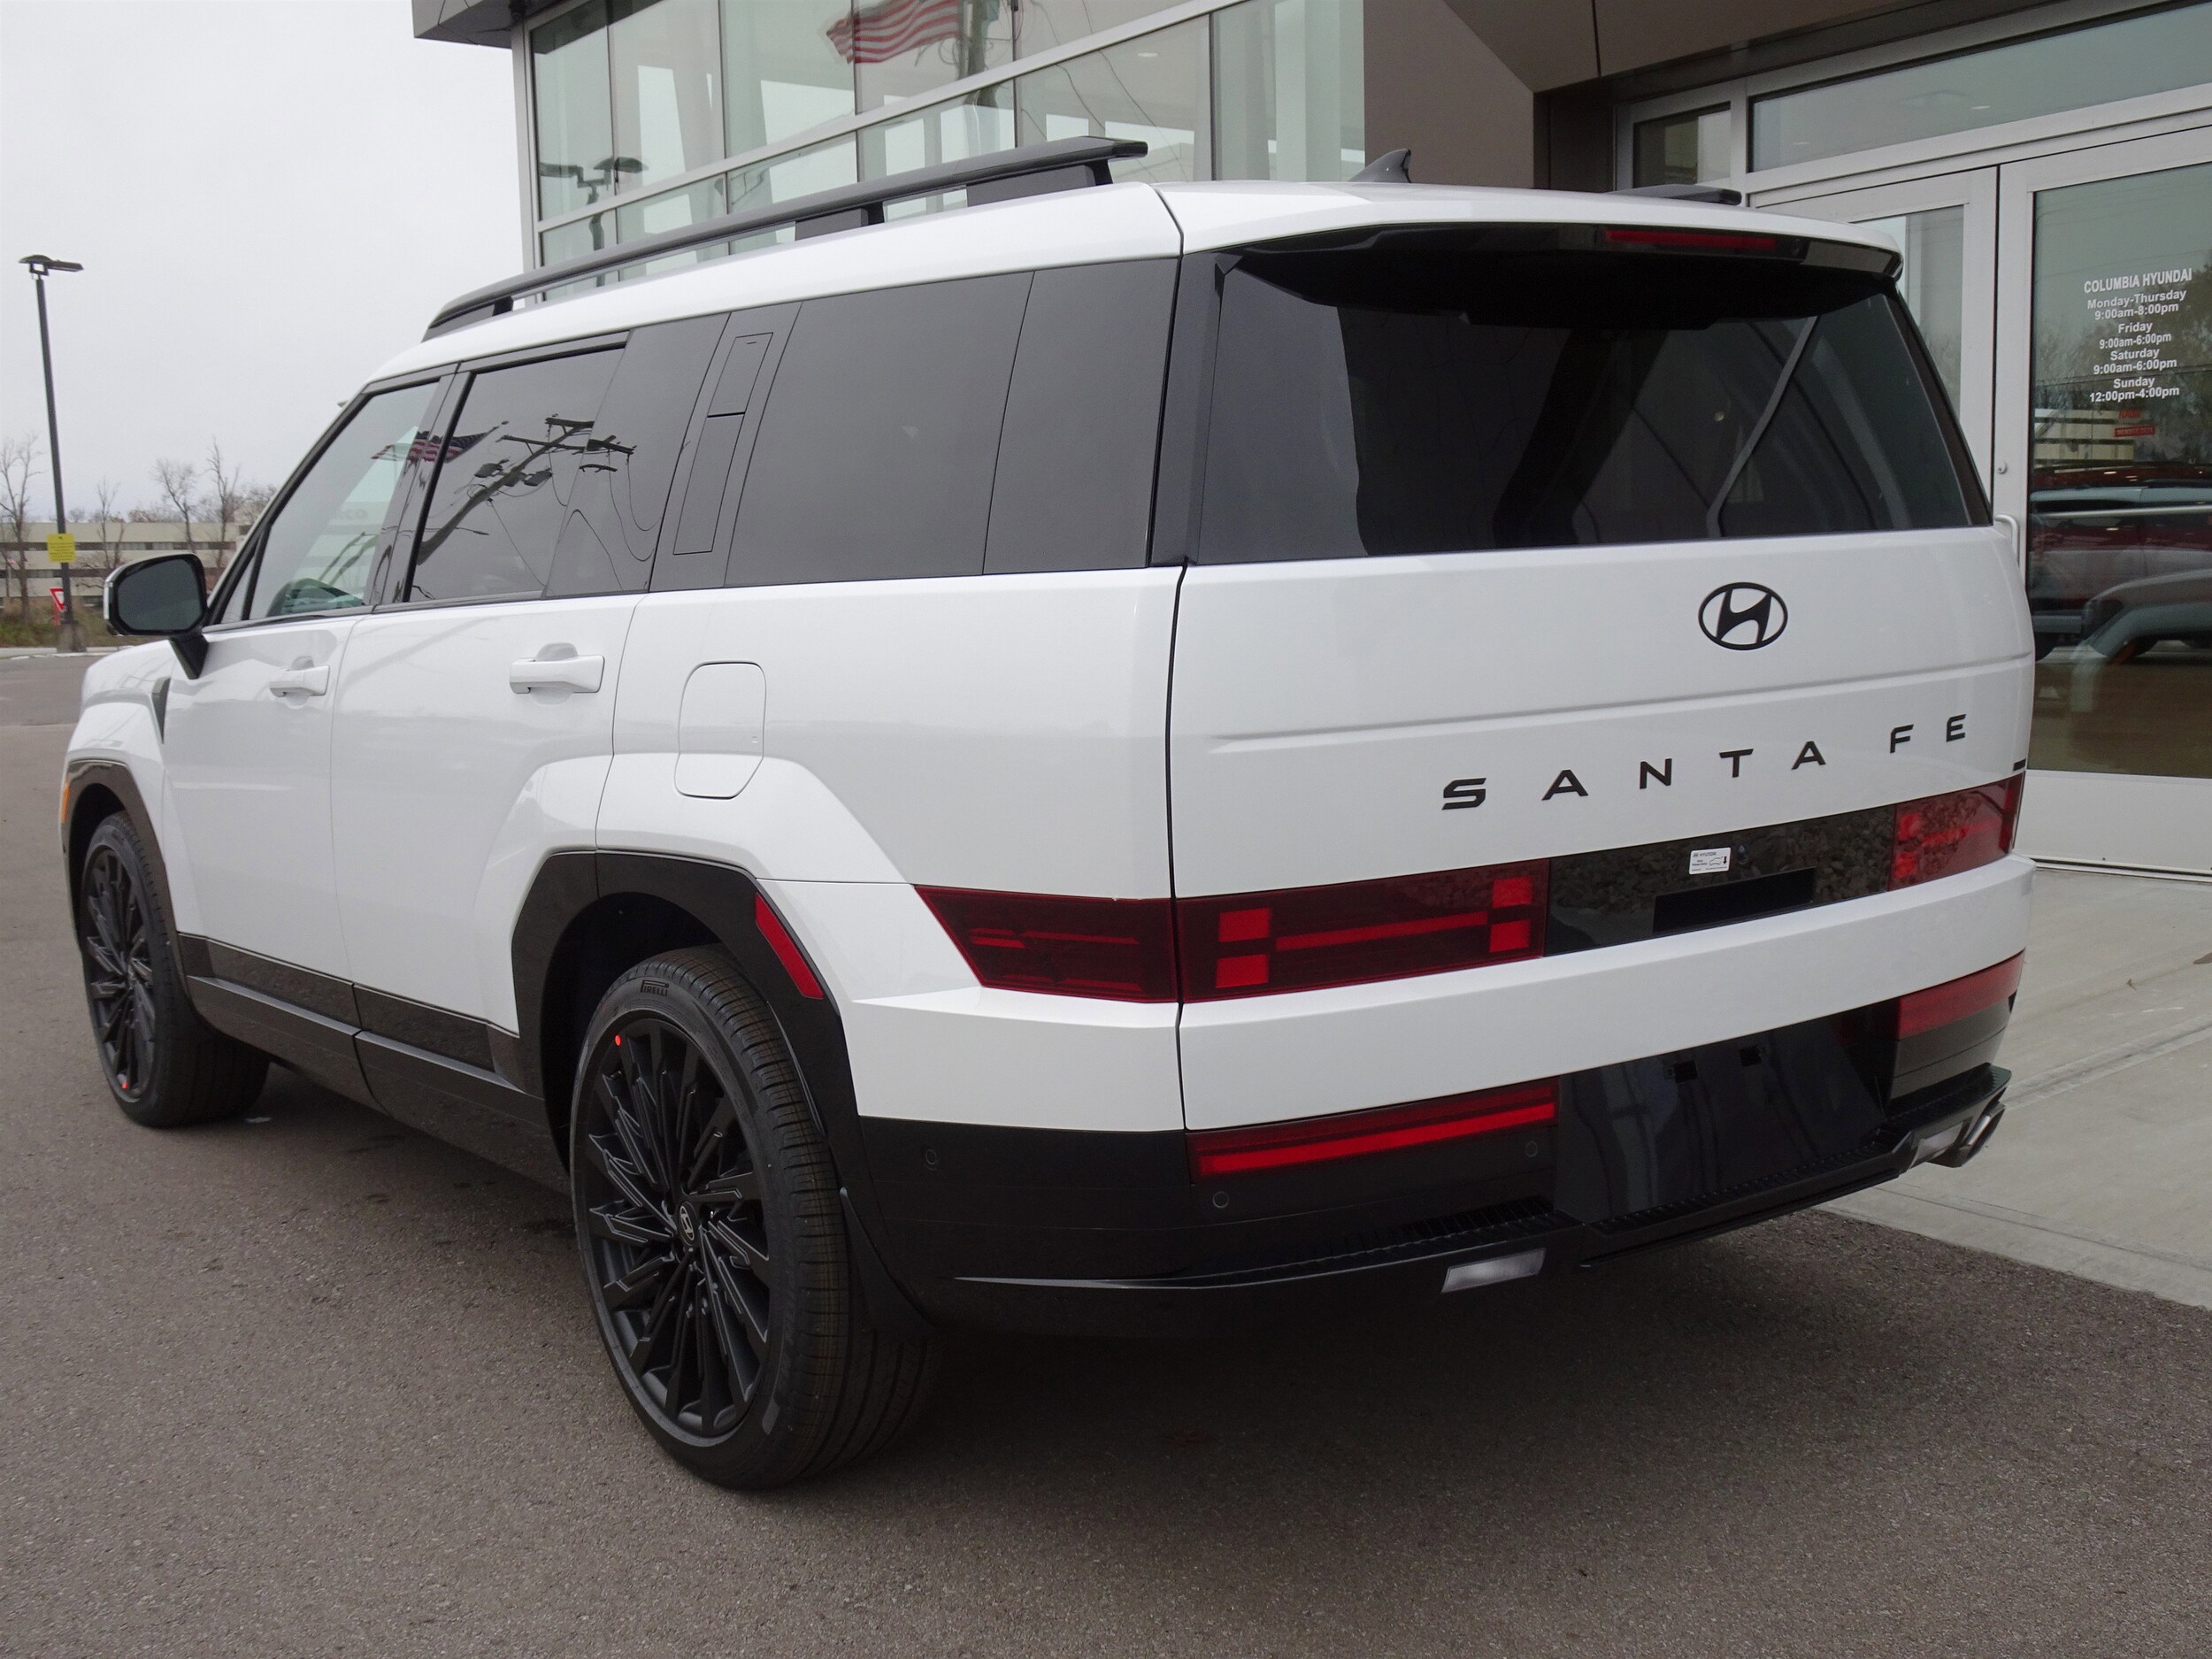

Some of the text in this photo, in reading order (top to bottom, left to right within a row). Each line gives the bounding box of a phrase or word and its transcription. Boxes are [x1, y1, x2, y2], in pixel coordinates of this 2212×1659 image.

[2084, 268, 2193, 294] COLUMBIA HYUNDAI
[2087, 289, 2187, 310] Monday-Thursday
[2094, 303, 2179, 320] 9:00am-8:00pm
[2118, 322, 2153, 334] Friday
[2099, 333, 2172, 349] 9:00am-6:00pm
[2110, 348, 2160, 361] Saturday
[2093, 358, 2177, 375] 9:00am-6:00pm
[2113, 376, 2155, 389] Sunday
[2089, 386, 2180, 403] 12:00pm-4:00pm
[1441, 713, 1966, 810] SANTA FE
[640, 979, 670, 997] PIRELLI
